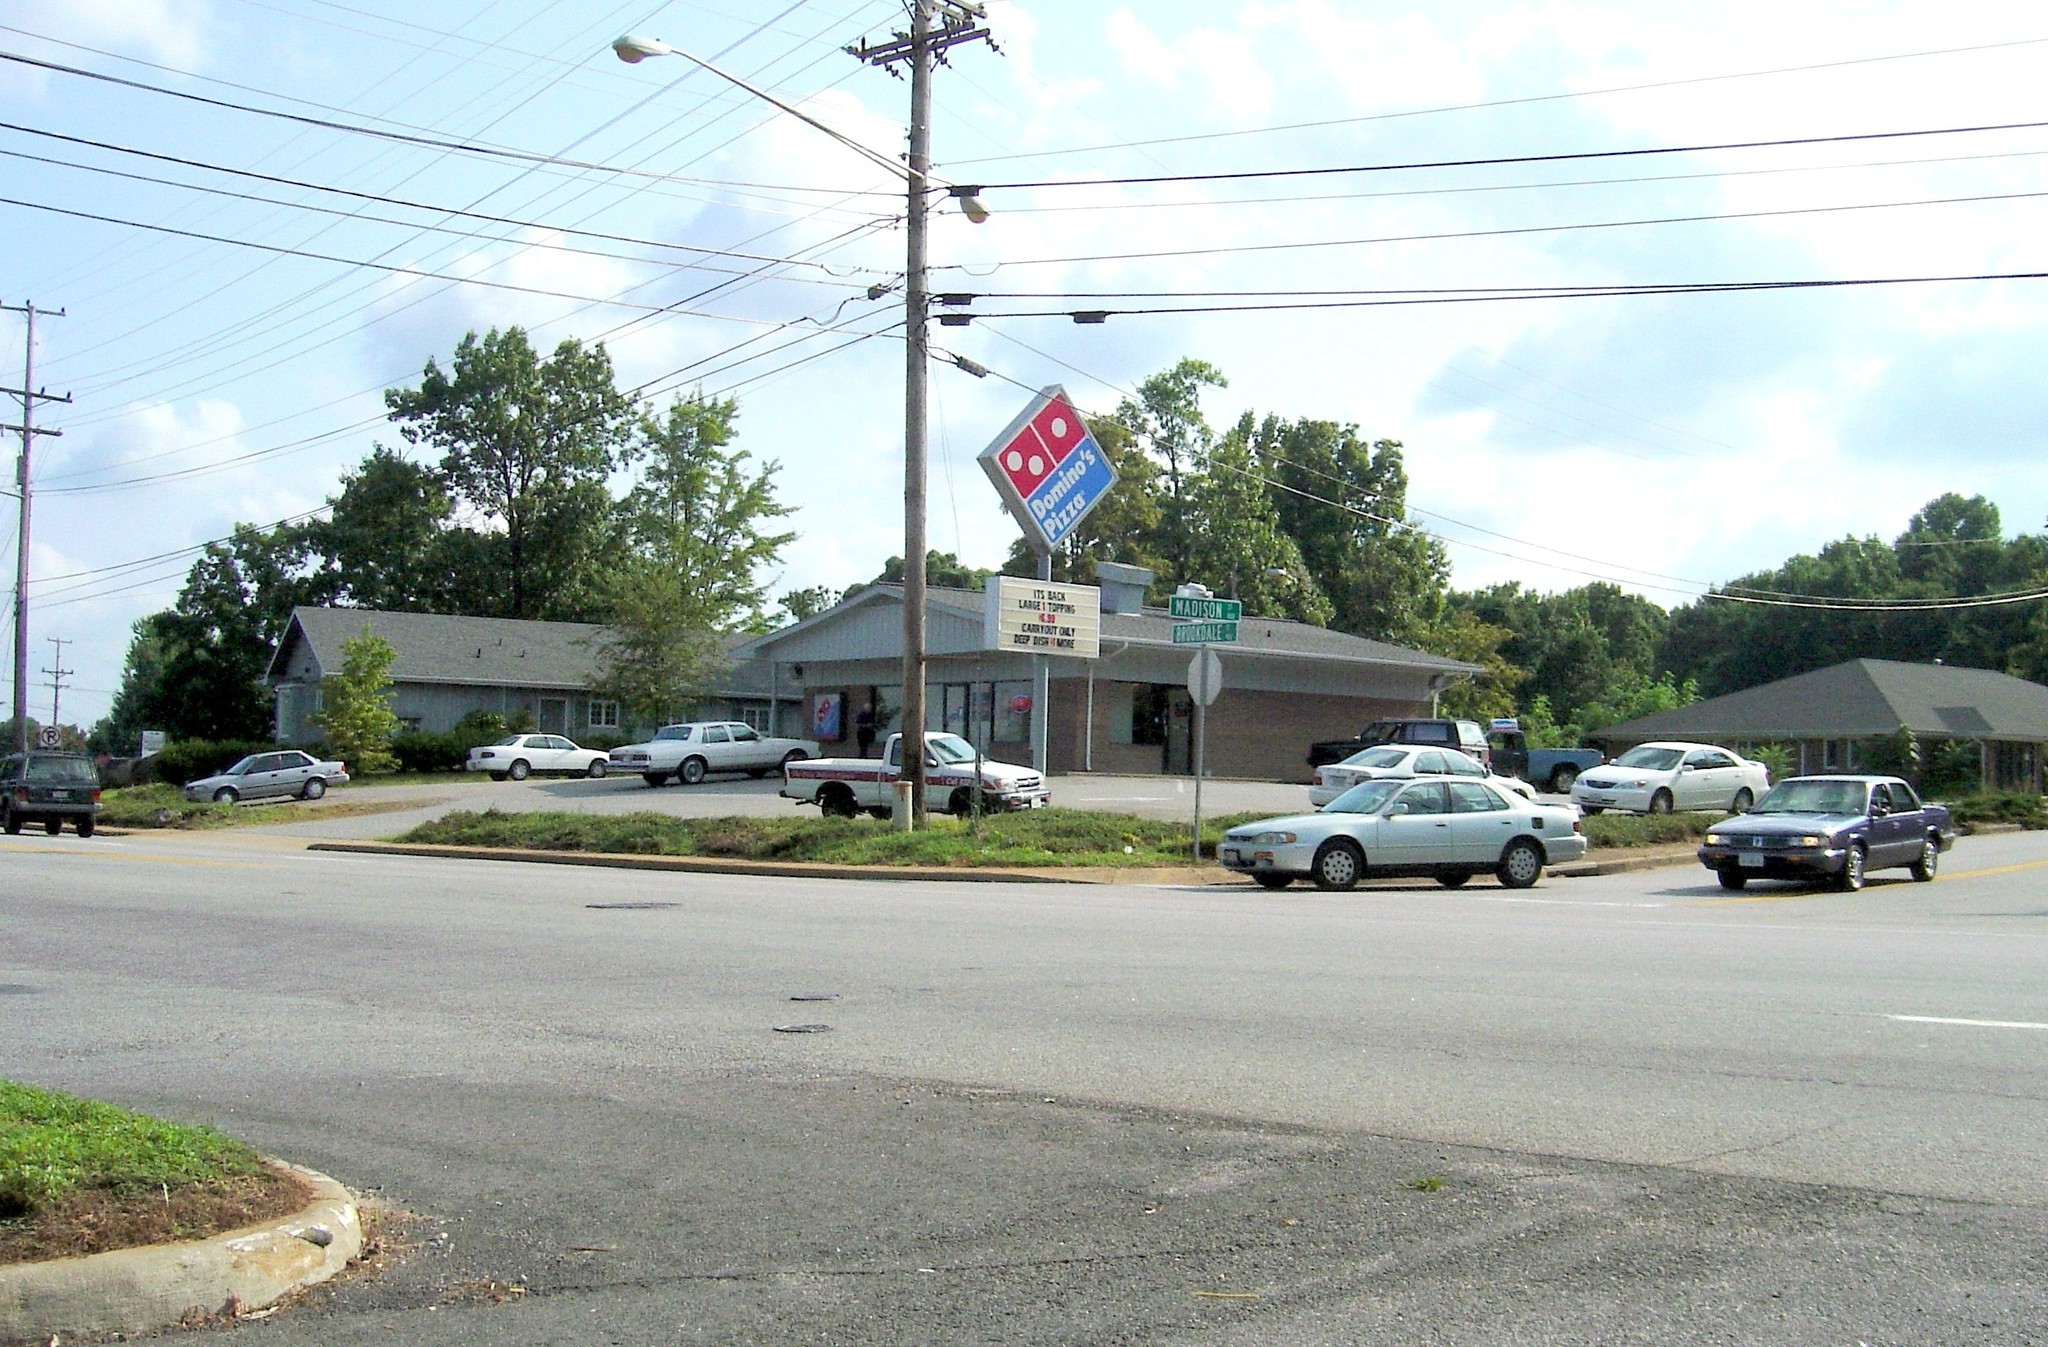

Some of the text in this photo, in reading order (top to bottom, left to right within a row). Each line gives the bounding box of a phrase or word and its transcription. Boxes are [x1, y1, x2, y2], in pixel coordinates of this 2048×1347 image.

[1030, 449, 1095, 519] Domino's
[1043, 493, 1086, 538] Pizza
[1033, 590, 1066, 602] ITS BACK
[1019, 600, 1040, 611] LARGE
[1048, 603, 1076, 614] TOPPING
[1175, 599, 1223, 618] MADISON
[1059, 626, 1076, 637] ONLY
[1176, 624, 1222, 642] BROOKDALE
[1014, 634, 1030, 644] DEEP
[1033, 636, 1049, 647] DISH
[1056, 639, 1075, 649] MORE
